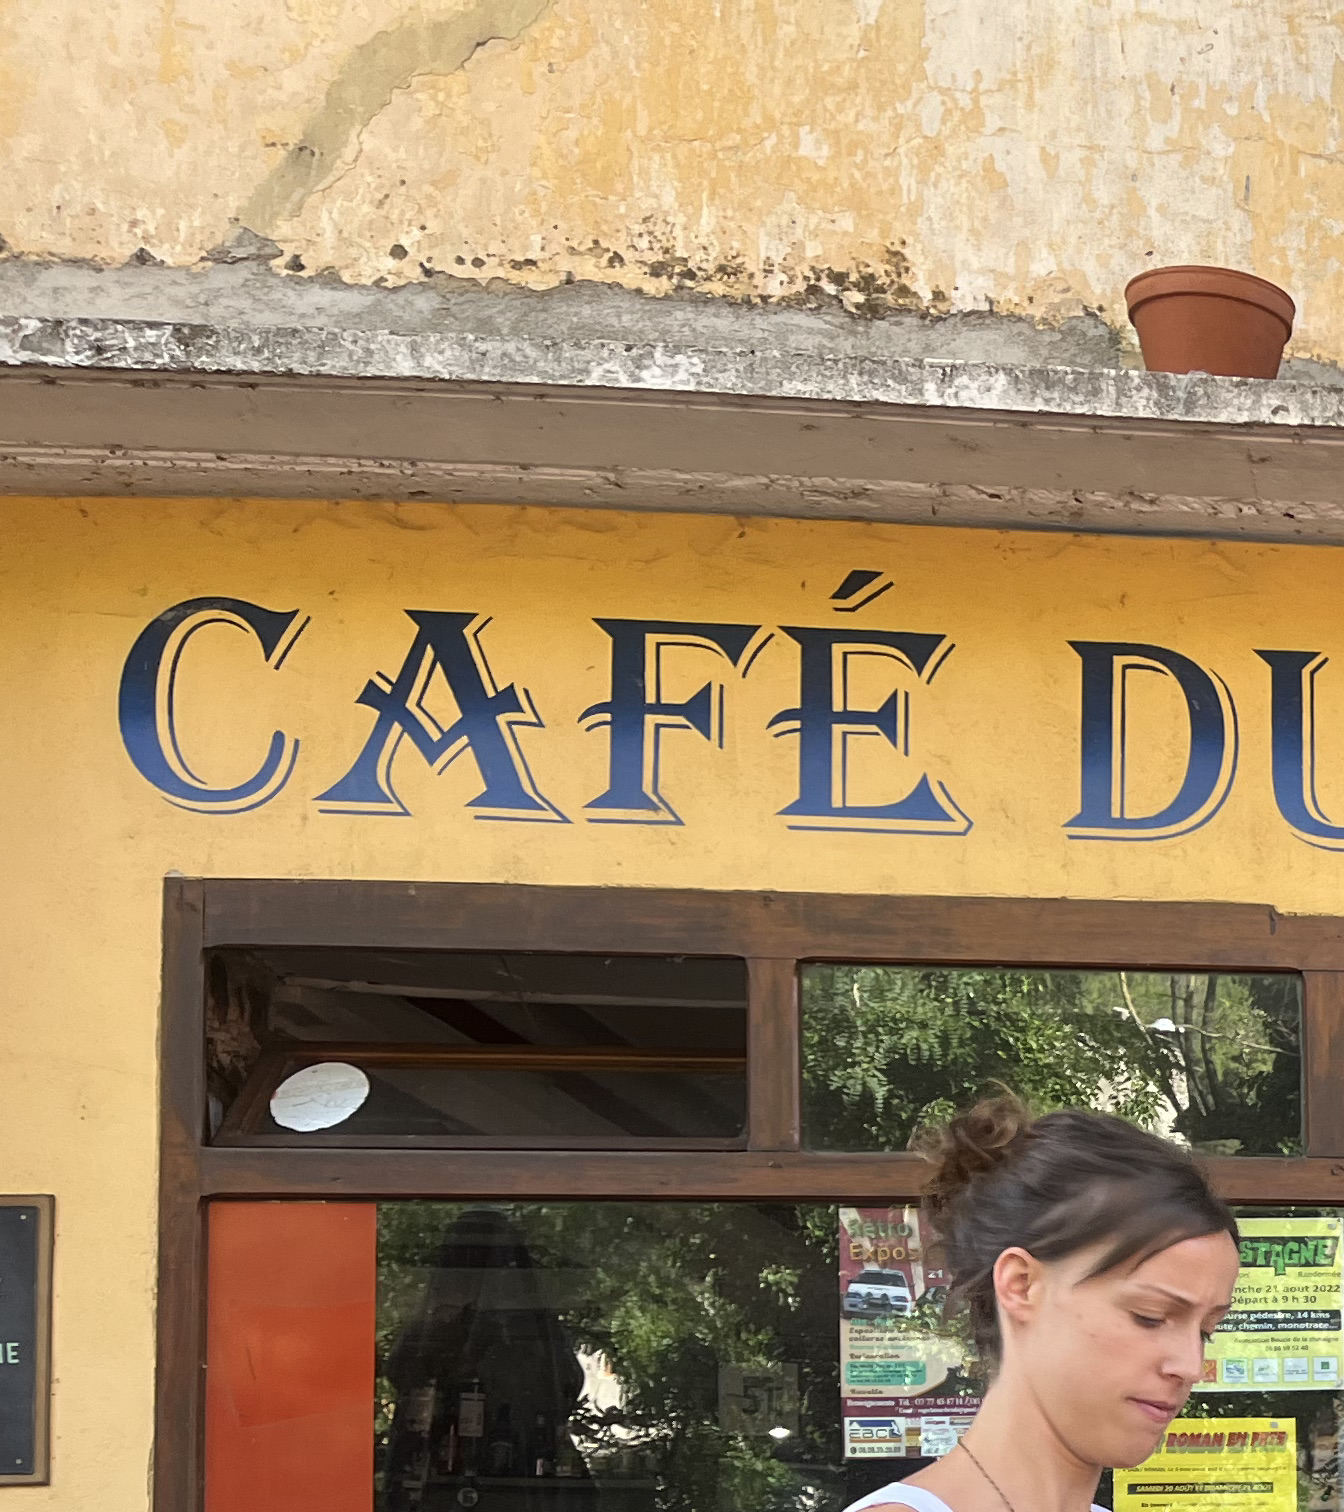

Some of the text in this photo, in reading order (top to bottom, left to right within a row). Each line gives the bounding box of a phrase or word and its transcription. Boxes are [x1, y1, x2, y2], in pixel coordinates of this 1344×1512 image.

[118, 570, 973, 836] CAFÉ
[1233, 1284, 1263, 1294] nche
[1313, 1284, 1341, 1293] 2022
